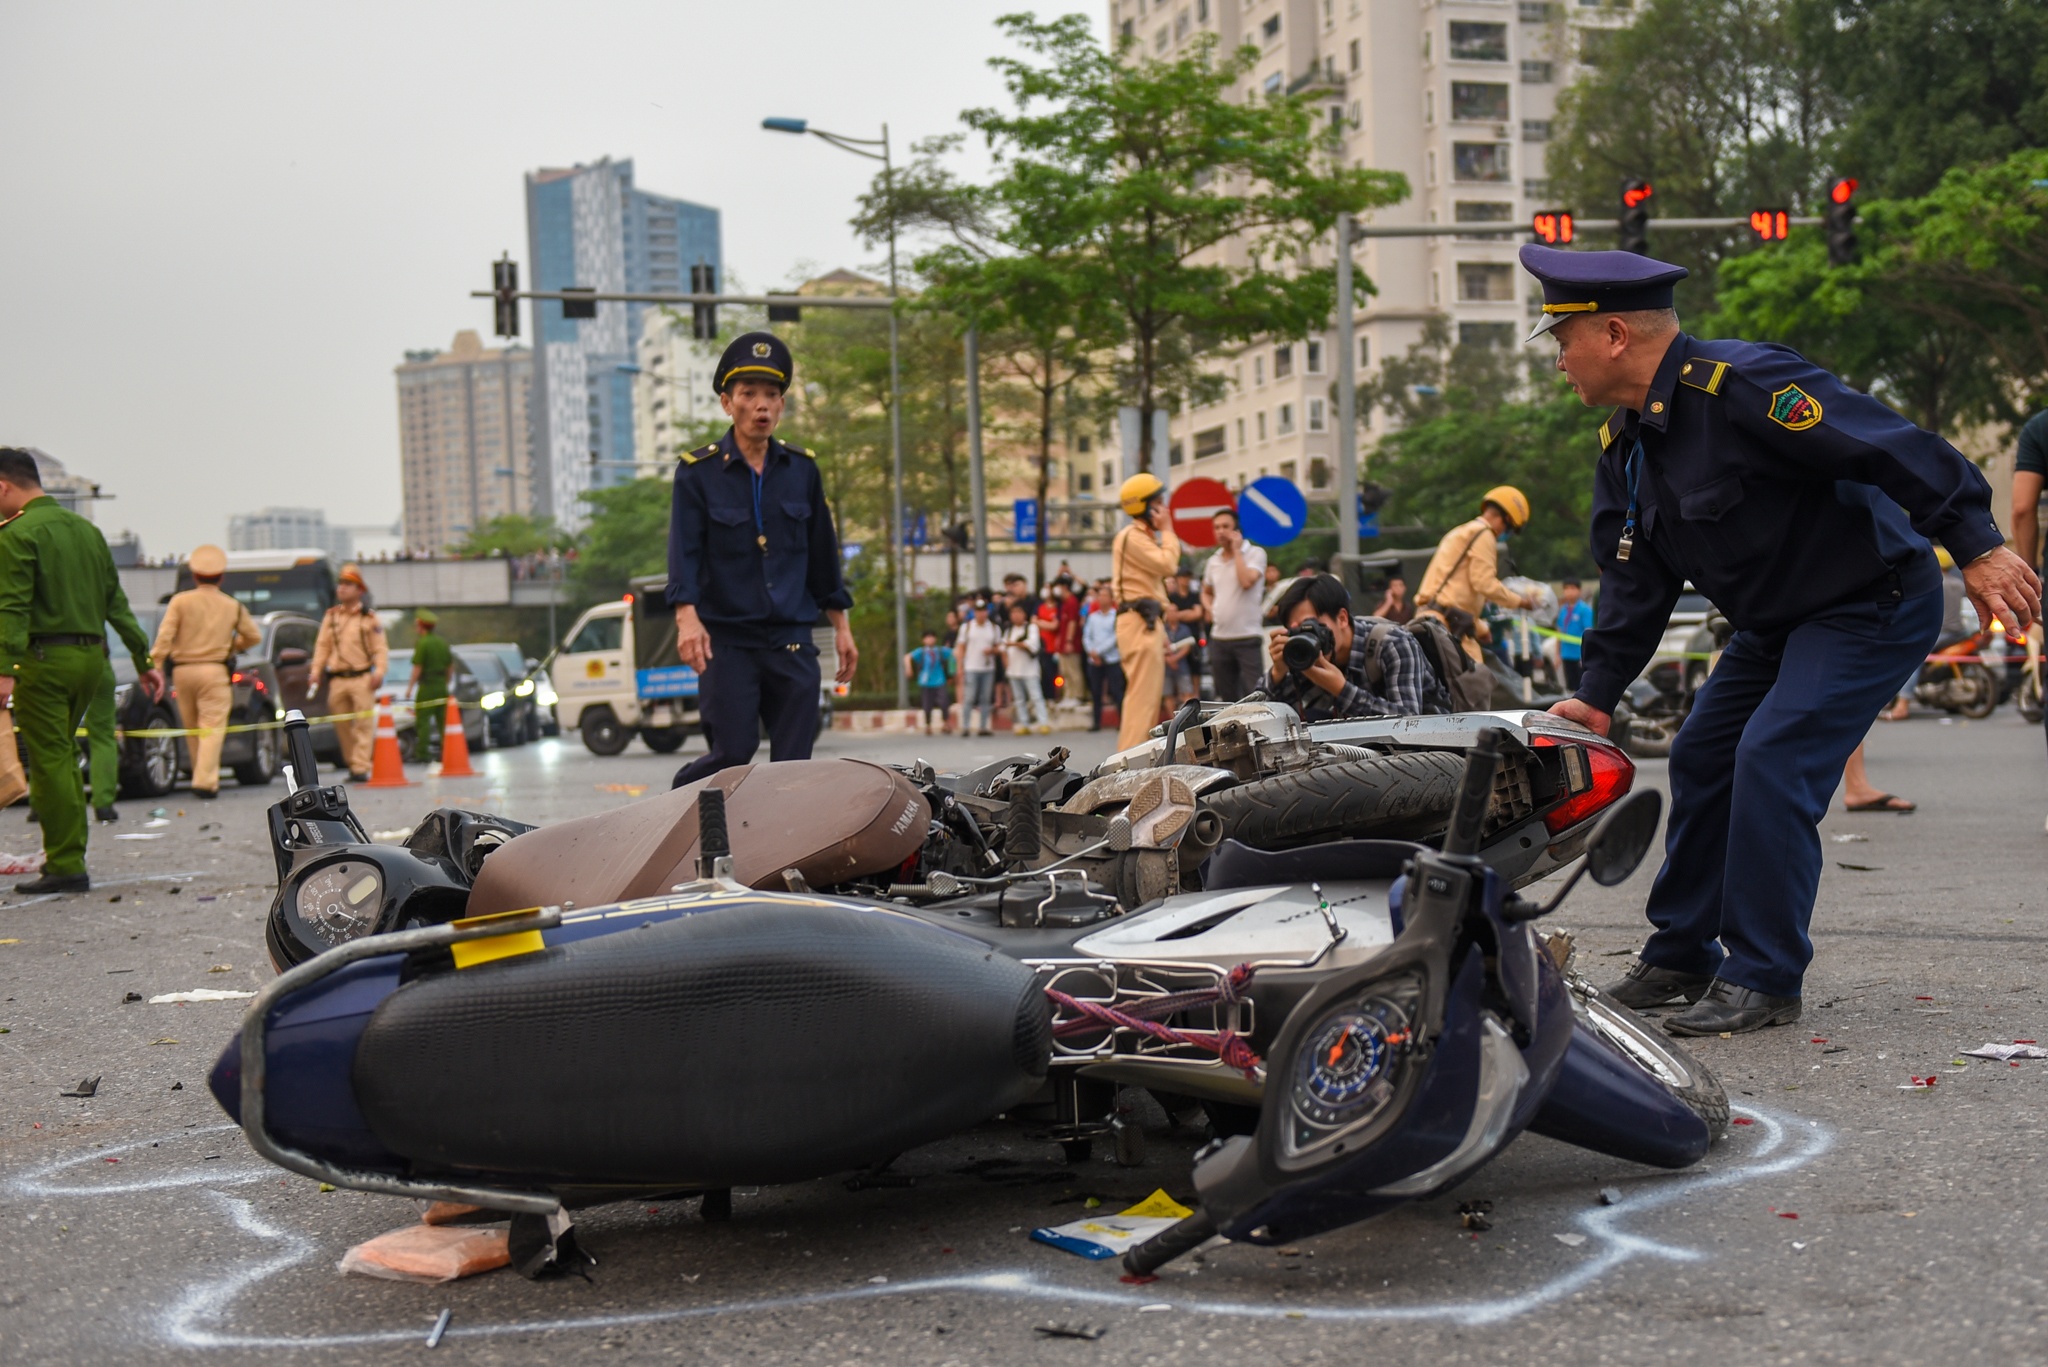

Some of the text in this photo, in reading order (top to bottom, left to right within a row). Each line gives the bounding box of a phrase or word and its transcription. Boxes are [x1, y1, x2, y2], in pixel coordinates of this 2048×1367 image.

[1534, 213, 1573, 243] 41
[1751, 211, 1788, 240] 41
[890, 799, 920, 836] YAMAHA
